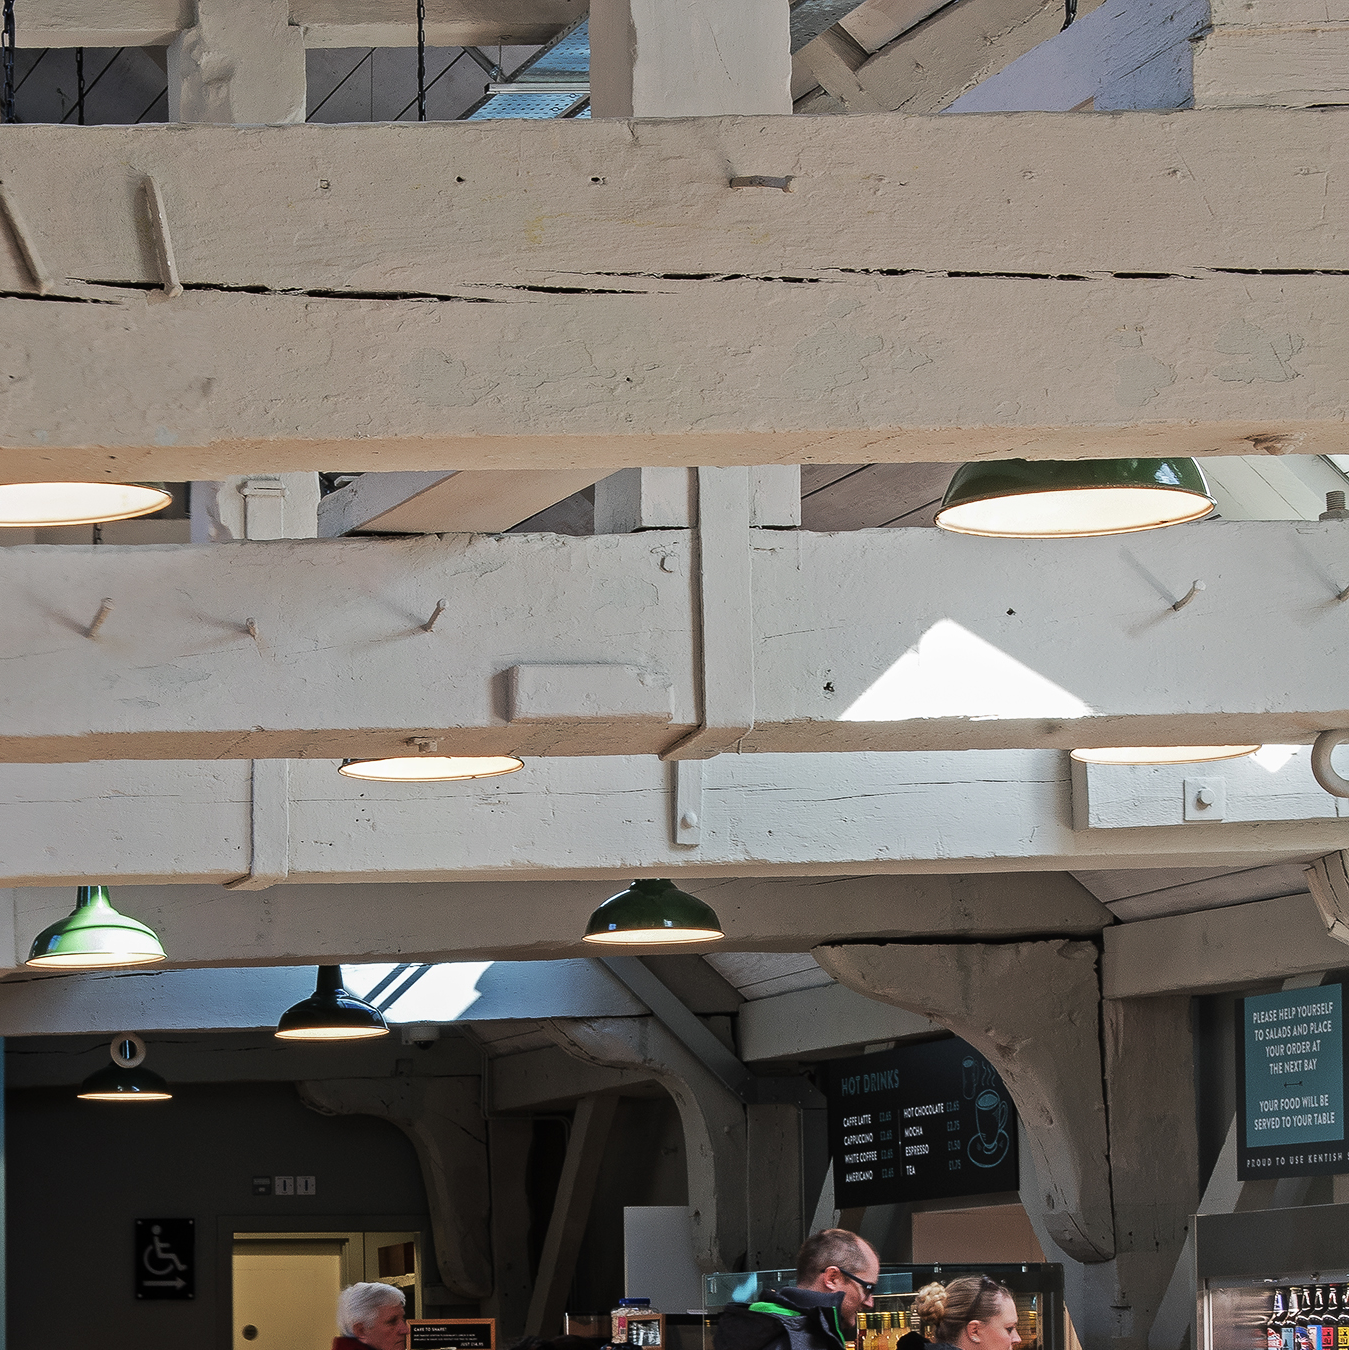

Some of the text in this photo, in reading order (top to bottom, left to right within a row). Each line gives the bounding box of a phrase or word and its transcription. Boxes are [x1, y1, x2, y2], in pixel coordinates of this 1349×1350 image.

[1253, 1002, 1333, 1024] PLEASE HELP YOURSELF
[1254, 1020, 1332, 1041] TO SALADS AND PLACE
[1265, 1040, 1321, 1058] YOUR ORDER AT
[1269, 1058, 1318, 1075] THE NEXT BAY
[841, 1068, 899, 1097] HOT DRINKS
[903, 1103, 944, 1119] HOT CHOCOLATE
[1259, 1094, 1329, 1113] YOUR FOOD WILL BE
[842, 1114, 872, 1128] CAFFE LATTE
[1254, 1112, 1335, 1131] SERVED TO YOUR TABLE
[843, 1132, 874, 1146] CAPPUCCINO
[904, 1126, 924, 1138] MOCHA
[844, 1150, 878, 1164] WHITE COFFEE
[905, 1144, 930, 1157] ESPRESSO
[1246, 1158, 1272, 1168] PROUD
[1276, 1157, 1285, 1166] TO
[1289, 1155, 1304, 1165] USE
[1308, 1152, 1343, 1164] KENTISH
[845, 1170, 874, 1183] AMERICANO
[906, 1165, 916, 1176] TEA
